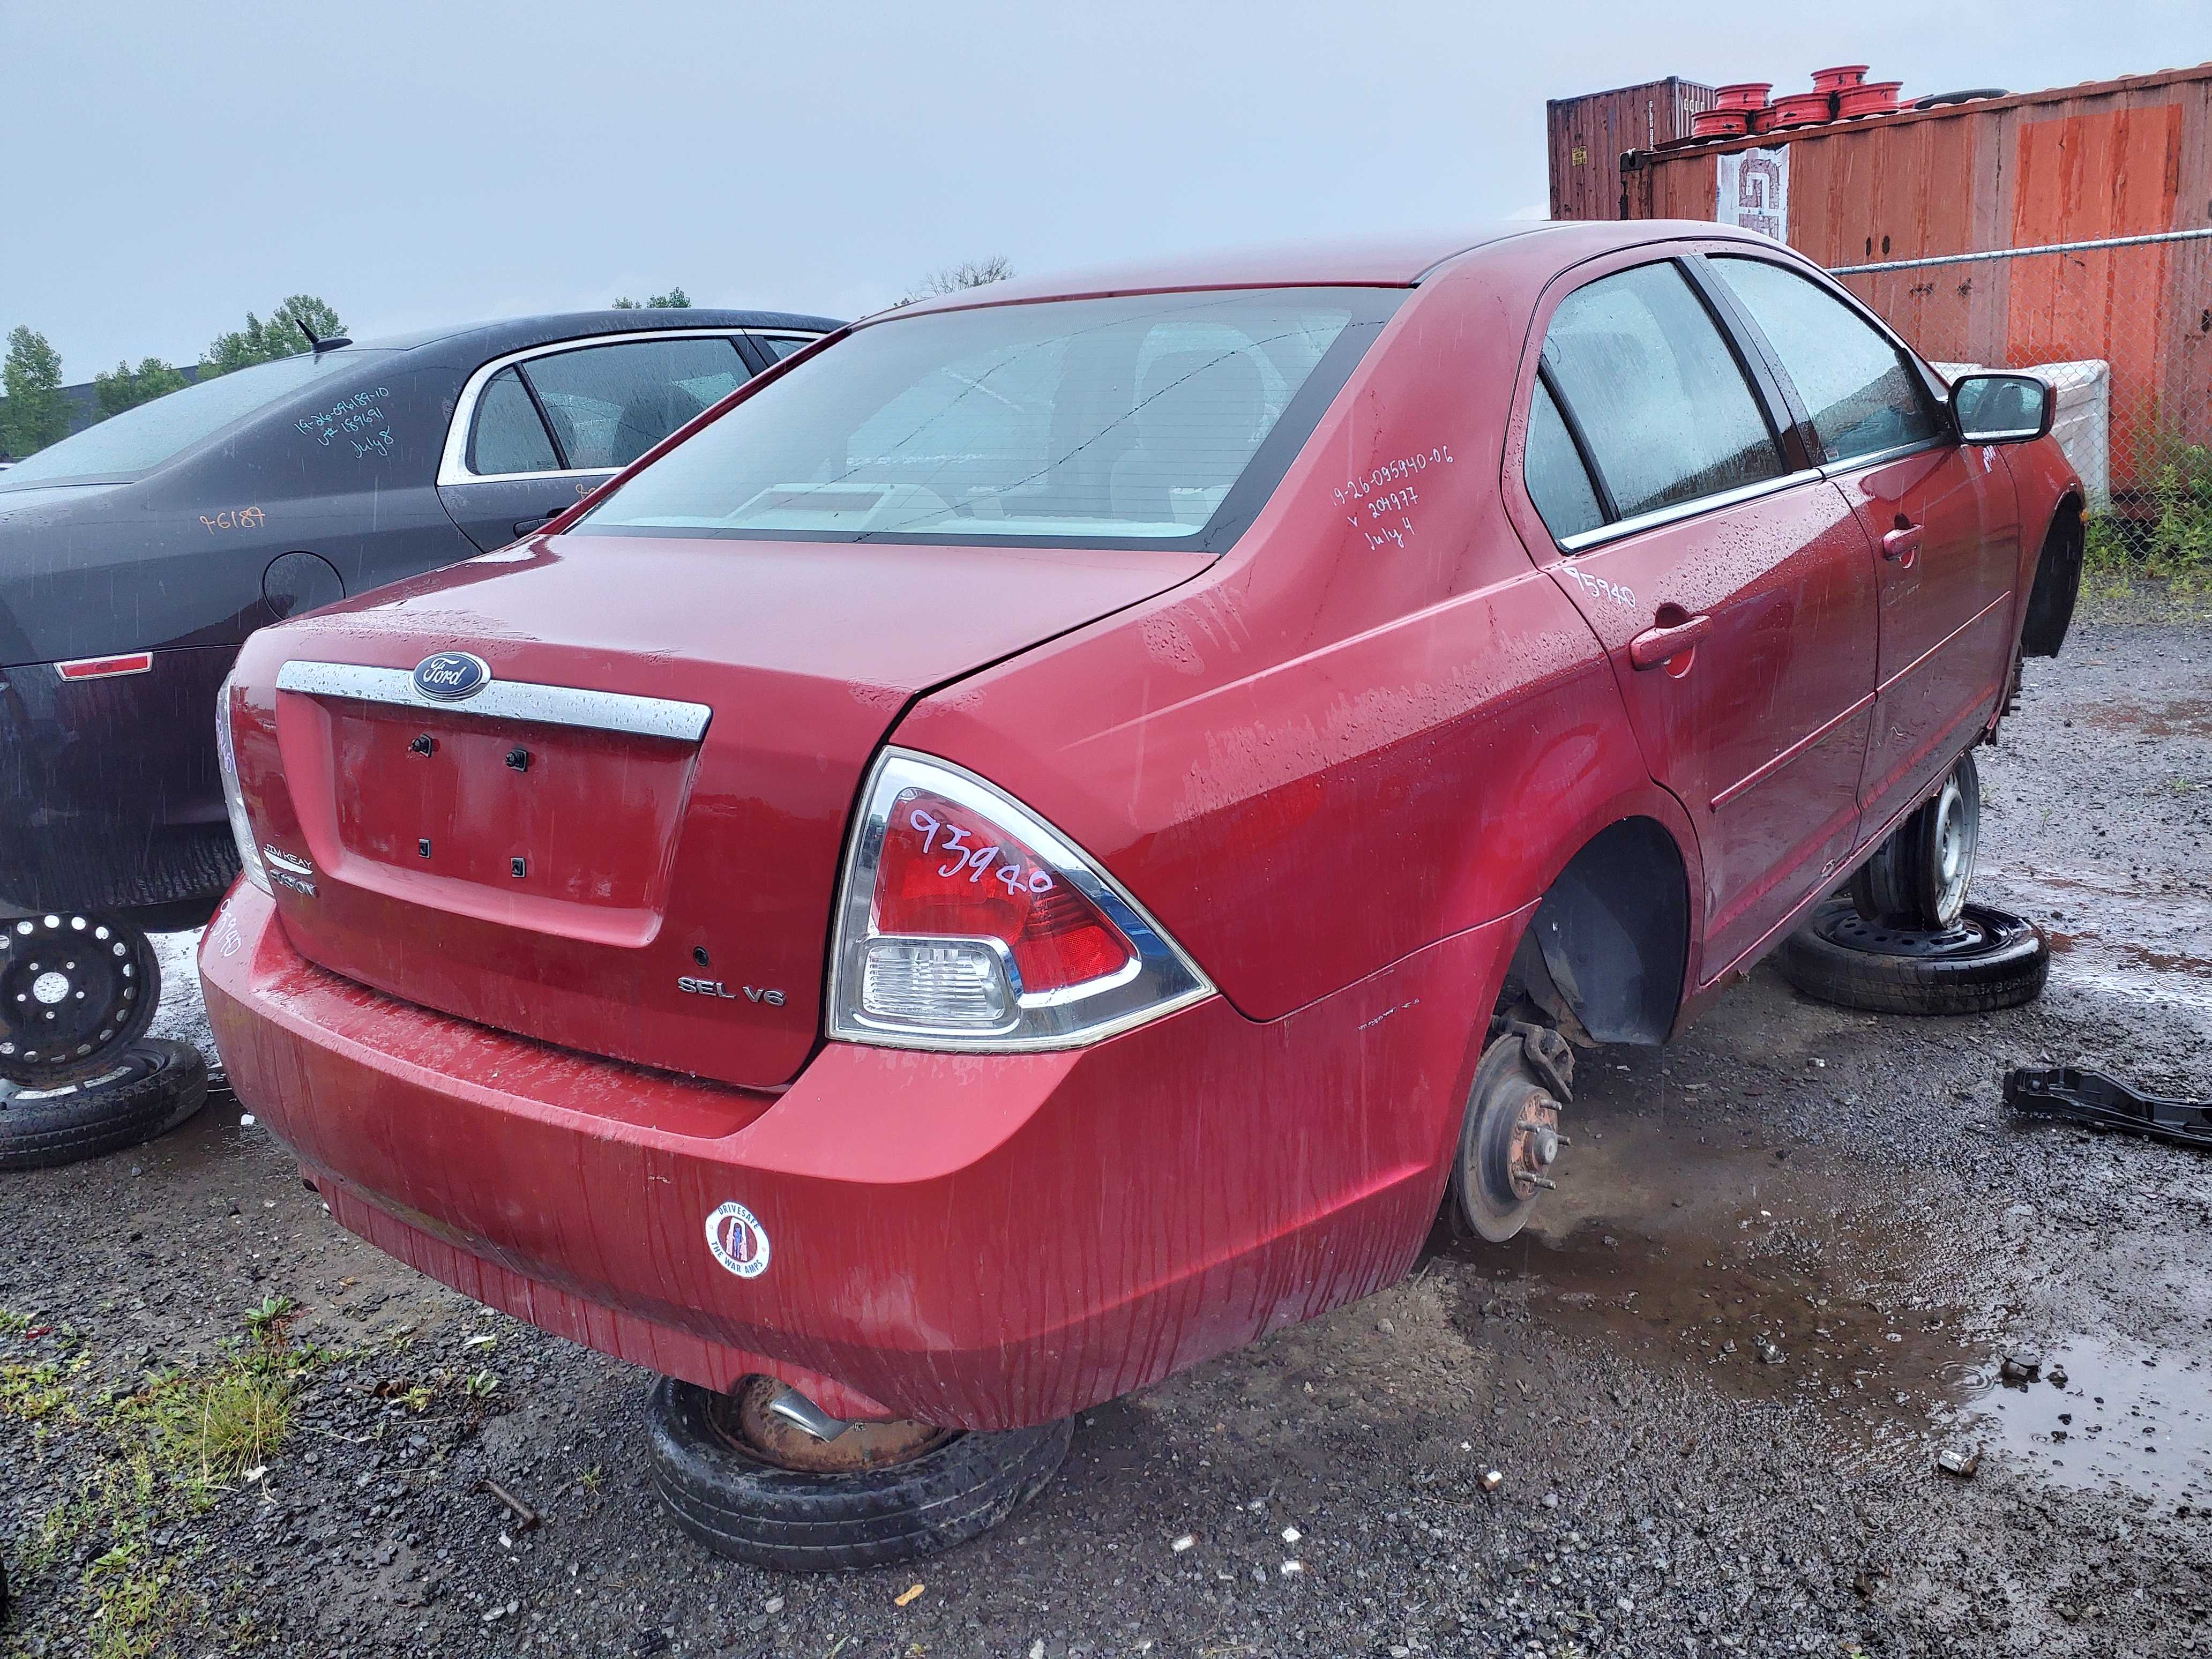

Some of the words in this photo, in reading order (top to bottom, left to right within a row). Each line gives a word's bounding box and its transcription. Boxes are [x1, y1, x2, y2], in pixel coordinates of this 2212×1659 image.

[350, 436, 387, 459] July
[379, 425, 394, 444] 8
[1331, 445, 1453, 506] 19-26-095940-06
[1368, 487, 1418, 519] 204977
[1365, 527, 1404, 550] July
[1402, 517, 1415, 535] 4
[423, 652, 467, 686] Ford
[263, 843, 282, 858] JIM
[282, 851, 312, 869] KEAY
[677, 976, 737, 999] SEL
[742, 985, 786, 1007] V6
[718, 1204, 760, 1230] DRIVESAFE
[711, 1241, 723, 1258] THE
[724, 1257, 741, 1272] WAR
[745, 1259, 763, 1274] AMPS
